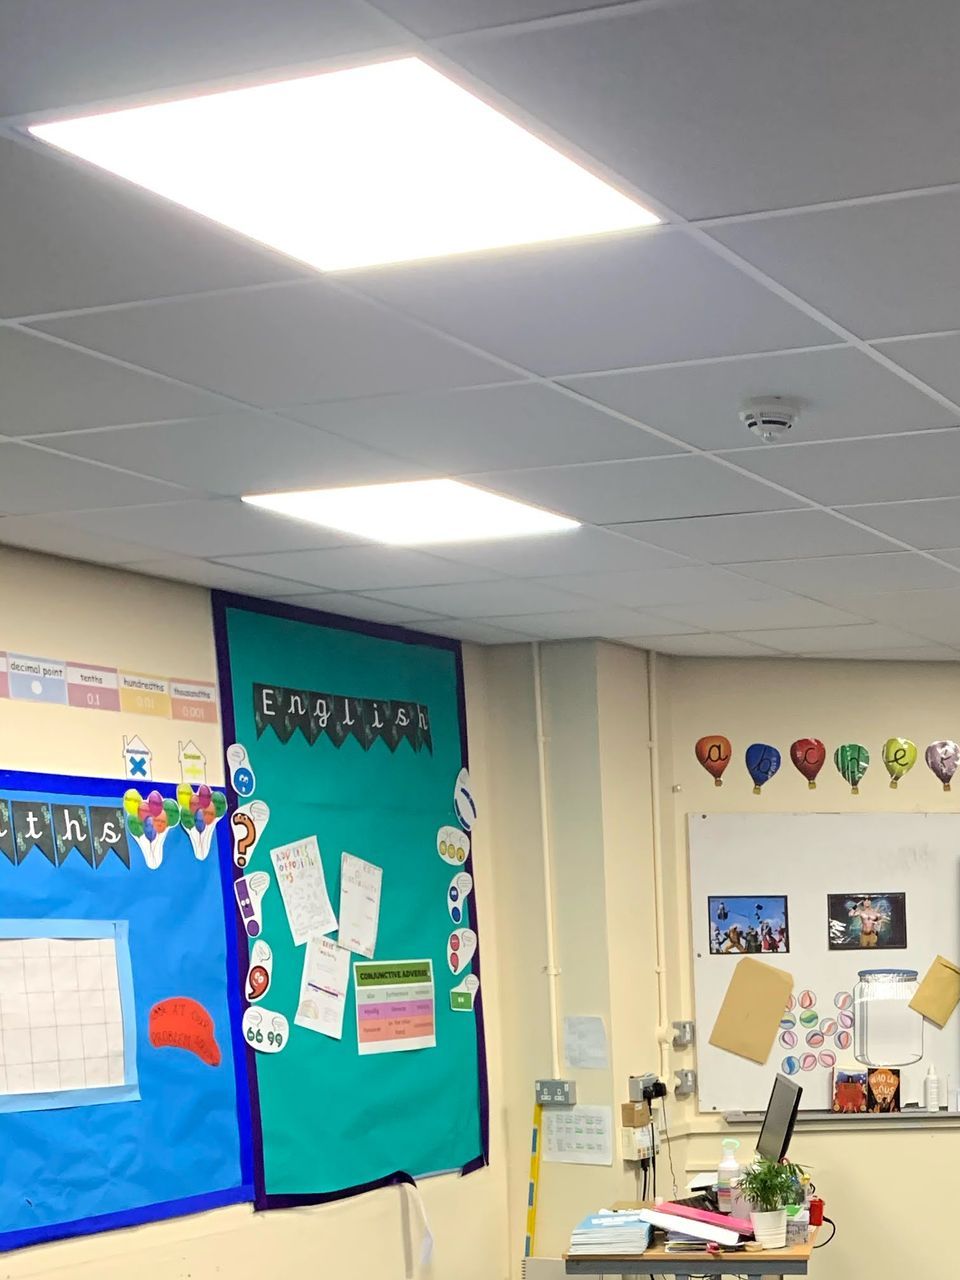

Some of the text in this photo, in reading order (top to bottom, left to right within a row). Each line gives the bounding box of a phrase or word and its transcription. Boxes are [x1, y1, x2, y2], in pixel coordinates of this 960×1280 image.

[10, 661, 63, 678] decimal point
[80, 673, 103, 685] tenths
[87, 693, 100, 706] 0.1
[262, 689, 428, 731] English
[704, 743, 729, 763] a
[887, 747, 909, 766] e
[360, 969, 427, 981] CONJUNCTIVE ADVERBS
